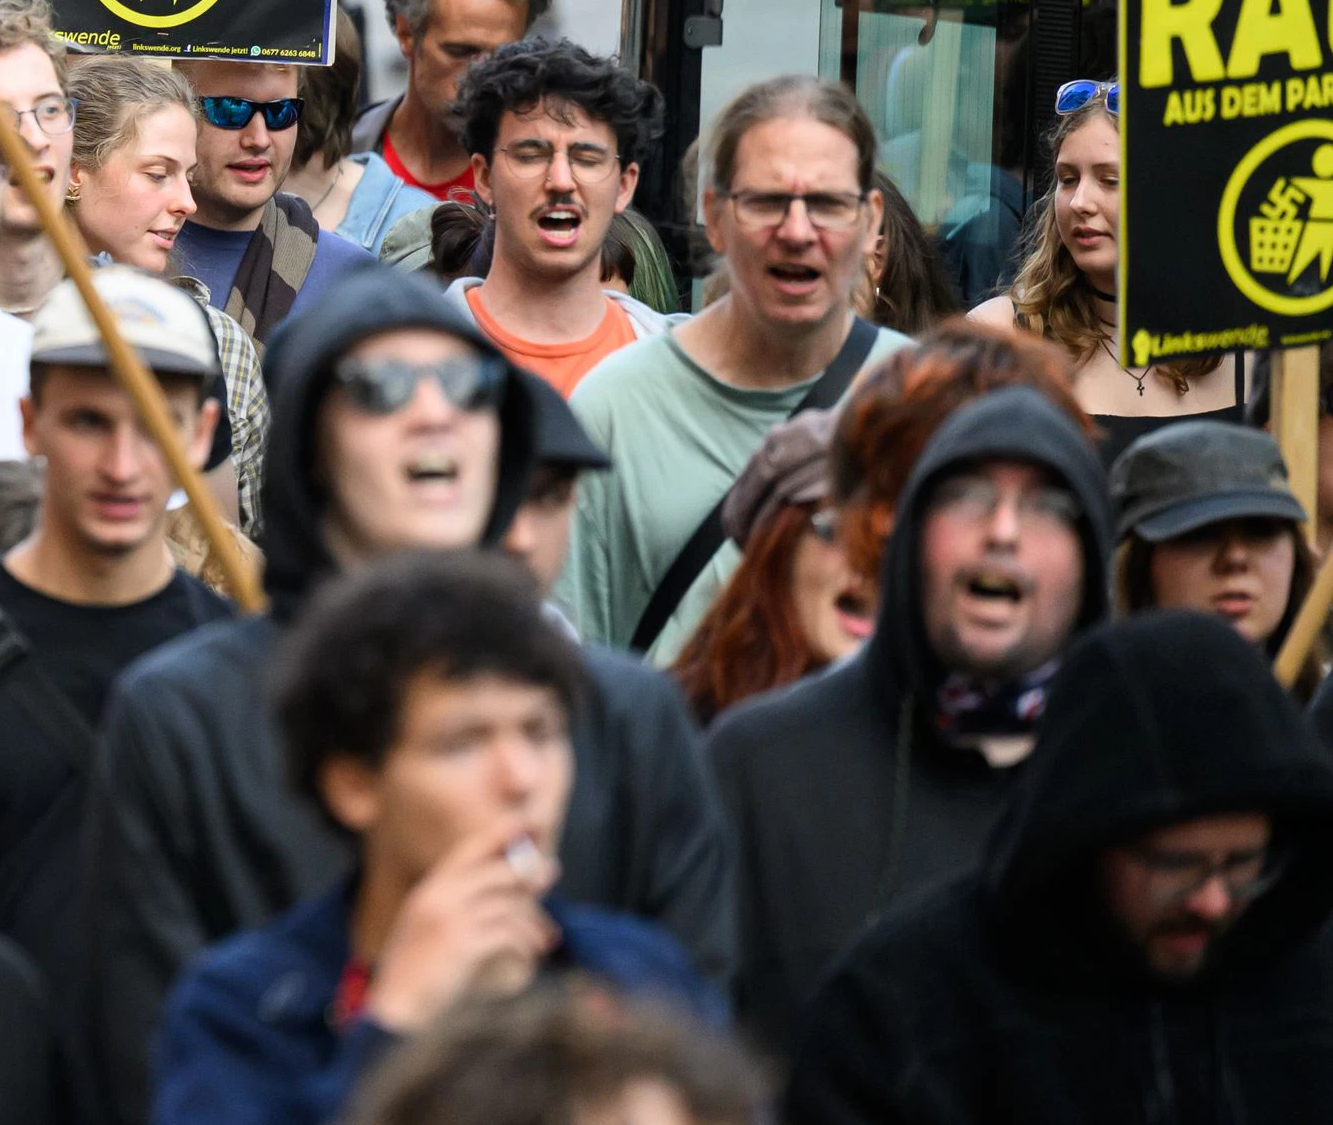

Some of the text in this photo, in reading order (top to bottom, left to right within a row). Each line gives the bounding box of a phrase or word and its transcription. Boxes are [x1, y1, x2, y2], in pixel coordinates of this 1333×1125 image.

[54, 30, 121, 46] swende
[133, 43, 316, 58] linkswende.org Linkswende jetzt! 0677 6263 6848
[1163, 88, 1216, 127] AUS
[1220, 80, 1282, 121] DEM
